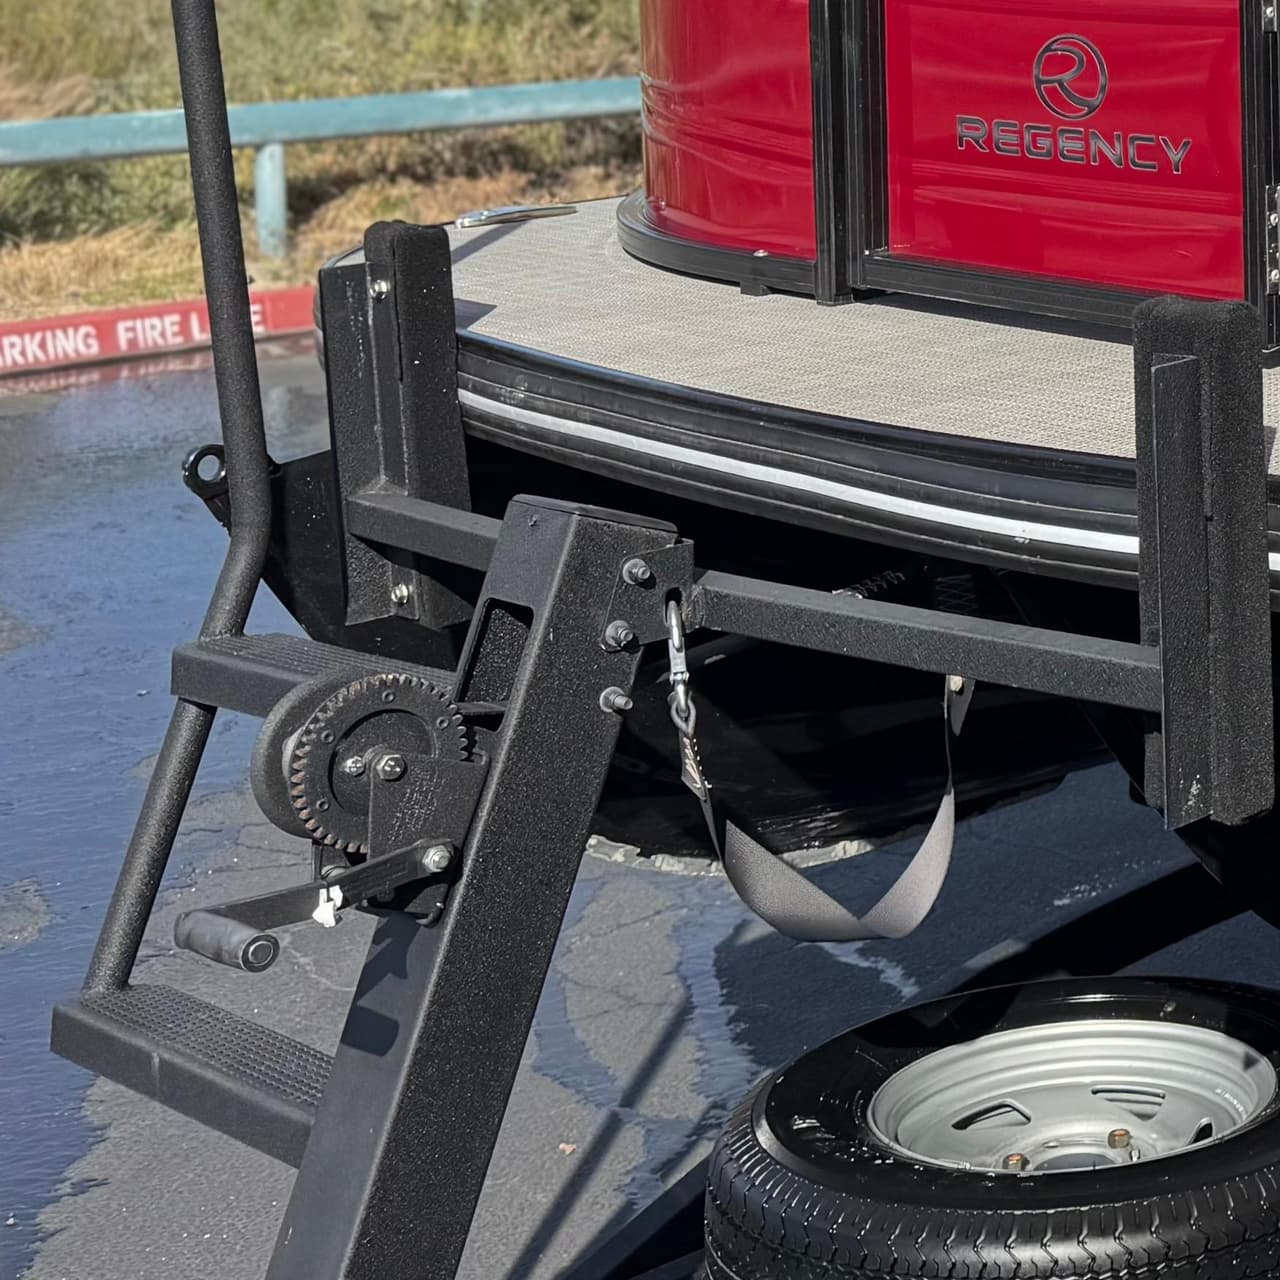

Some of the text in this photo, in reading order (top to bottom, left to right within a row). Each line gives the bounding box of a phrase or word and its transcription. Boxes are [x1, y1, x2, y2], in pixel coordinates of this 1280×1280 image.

[955, 114, 1193, 175] REGENCY
[0, 303, 267, 368] RKING FIRE LE
